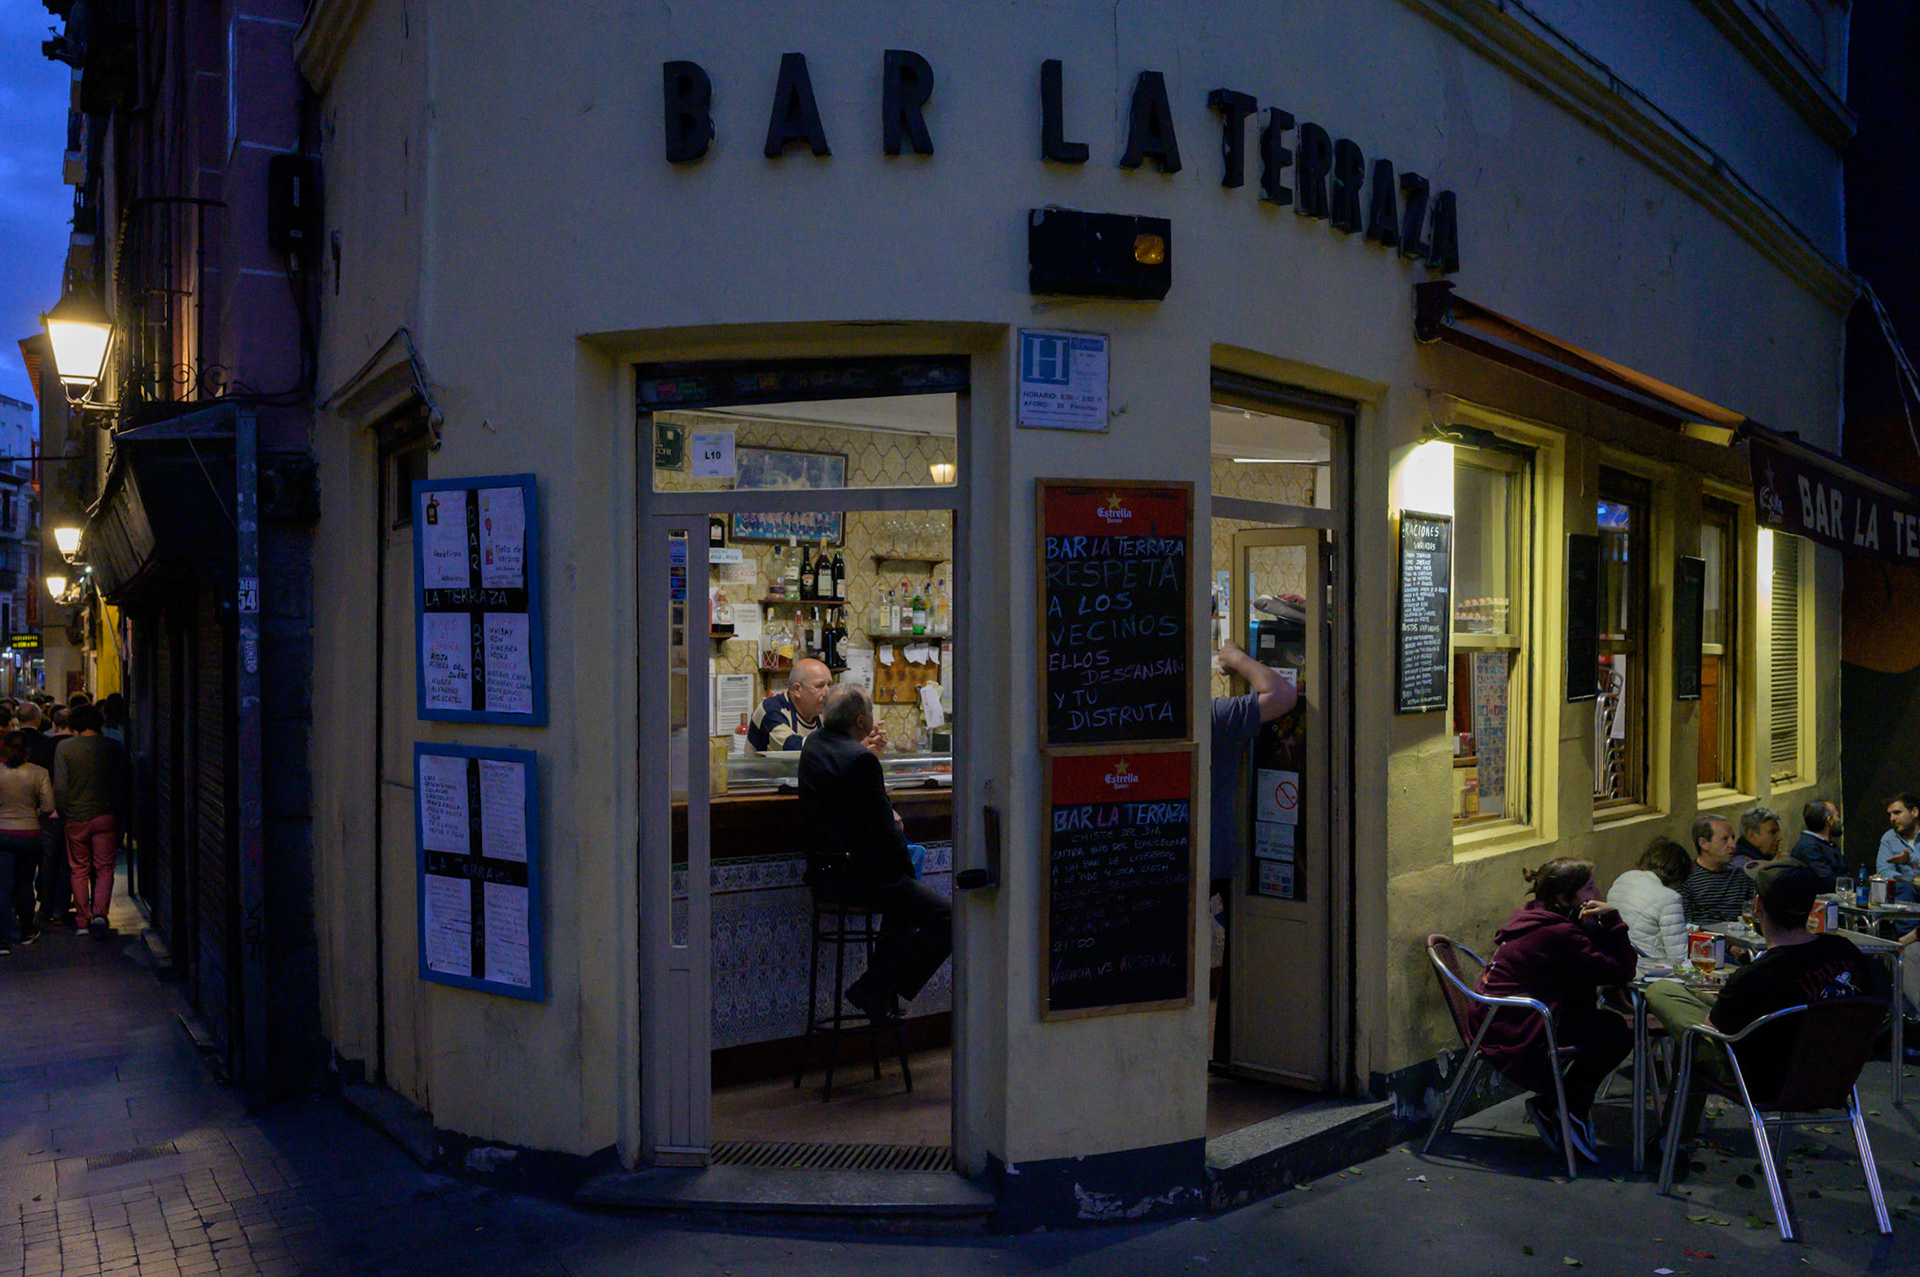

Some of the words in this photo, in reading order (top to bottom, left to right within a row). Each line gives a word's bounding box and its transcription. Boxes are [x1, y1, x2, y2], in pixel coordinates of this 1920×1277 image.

[663, 49, 934, 163] BAR
[1041, 59, 1181, 174] LA
[1208, 88, 1460, 274] TERRAZA
[1027, 338, 1069, 380] H
[705, 451, 722, 459] L10
[1096, 507, 1132, 518] Estrella
[1798, 473, 1844, 541] BAR
[1853, 497, 1879, 550] LA
[1893, 510, 1920, 558] TE
[467, 505, 480, 570] BAR
[1404, 523, 1439, 537] RACIONES
[1046, 536, 1087, 559] BAR
[1091, 537, 1111, 557] LA
[1114, 536, 1185, 557] TERRAZA
[1046, 557, 1178, 592] RESPETA
[238, 591, 256, 610] 54
[425, 590, 440, 607] LA
[445, 588, 508, 605] TERRAZA
[1048, 595, 1062, 619] A
[1078, 591, 1133, 615] LOS
[489, 628, 513, 636] WHISKY
[1050, 614, 1178, 647] VECINOS
[430, 652, 448, 660] RIOJA
[472, 623, 483, 683] BAR
[1049, 649, 1110, 671] ELLOS
[448, 672, 468, 680] DUERO
[1081, 658, 1184, 686] DESCANSAN
[431, 695, 462, 704] MOSCATEL
[1054, 691, 1065, 710] Y
[1072, 688, 1098, 706] TU
[1067, 700, 1173, 730] DISFRUTA
[1104, 773, 1139, 784] Estrella
[1053, 805, 1094, 832] BAR
[1097, 805, 1120, 827] LA
[1122, 802, 1189, 825] TERRAZA
[1071, 830, 1113, 842] CHISTE
[1051, 847, 1084, 860] ENTRA
[1134, 837, 1188, 849] BARCELONA
[428, 854, 446, 871] LA
